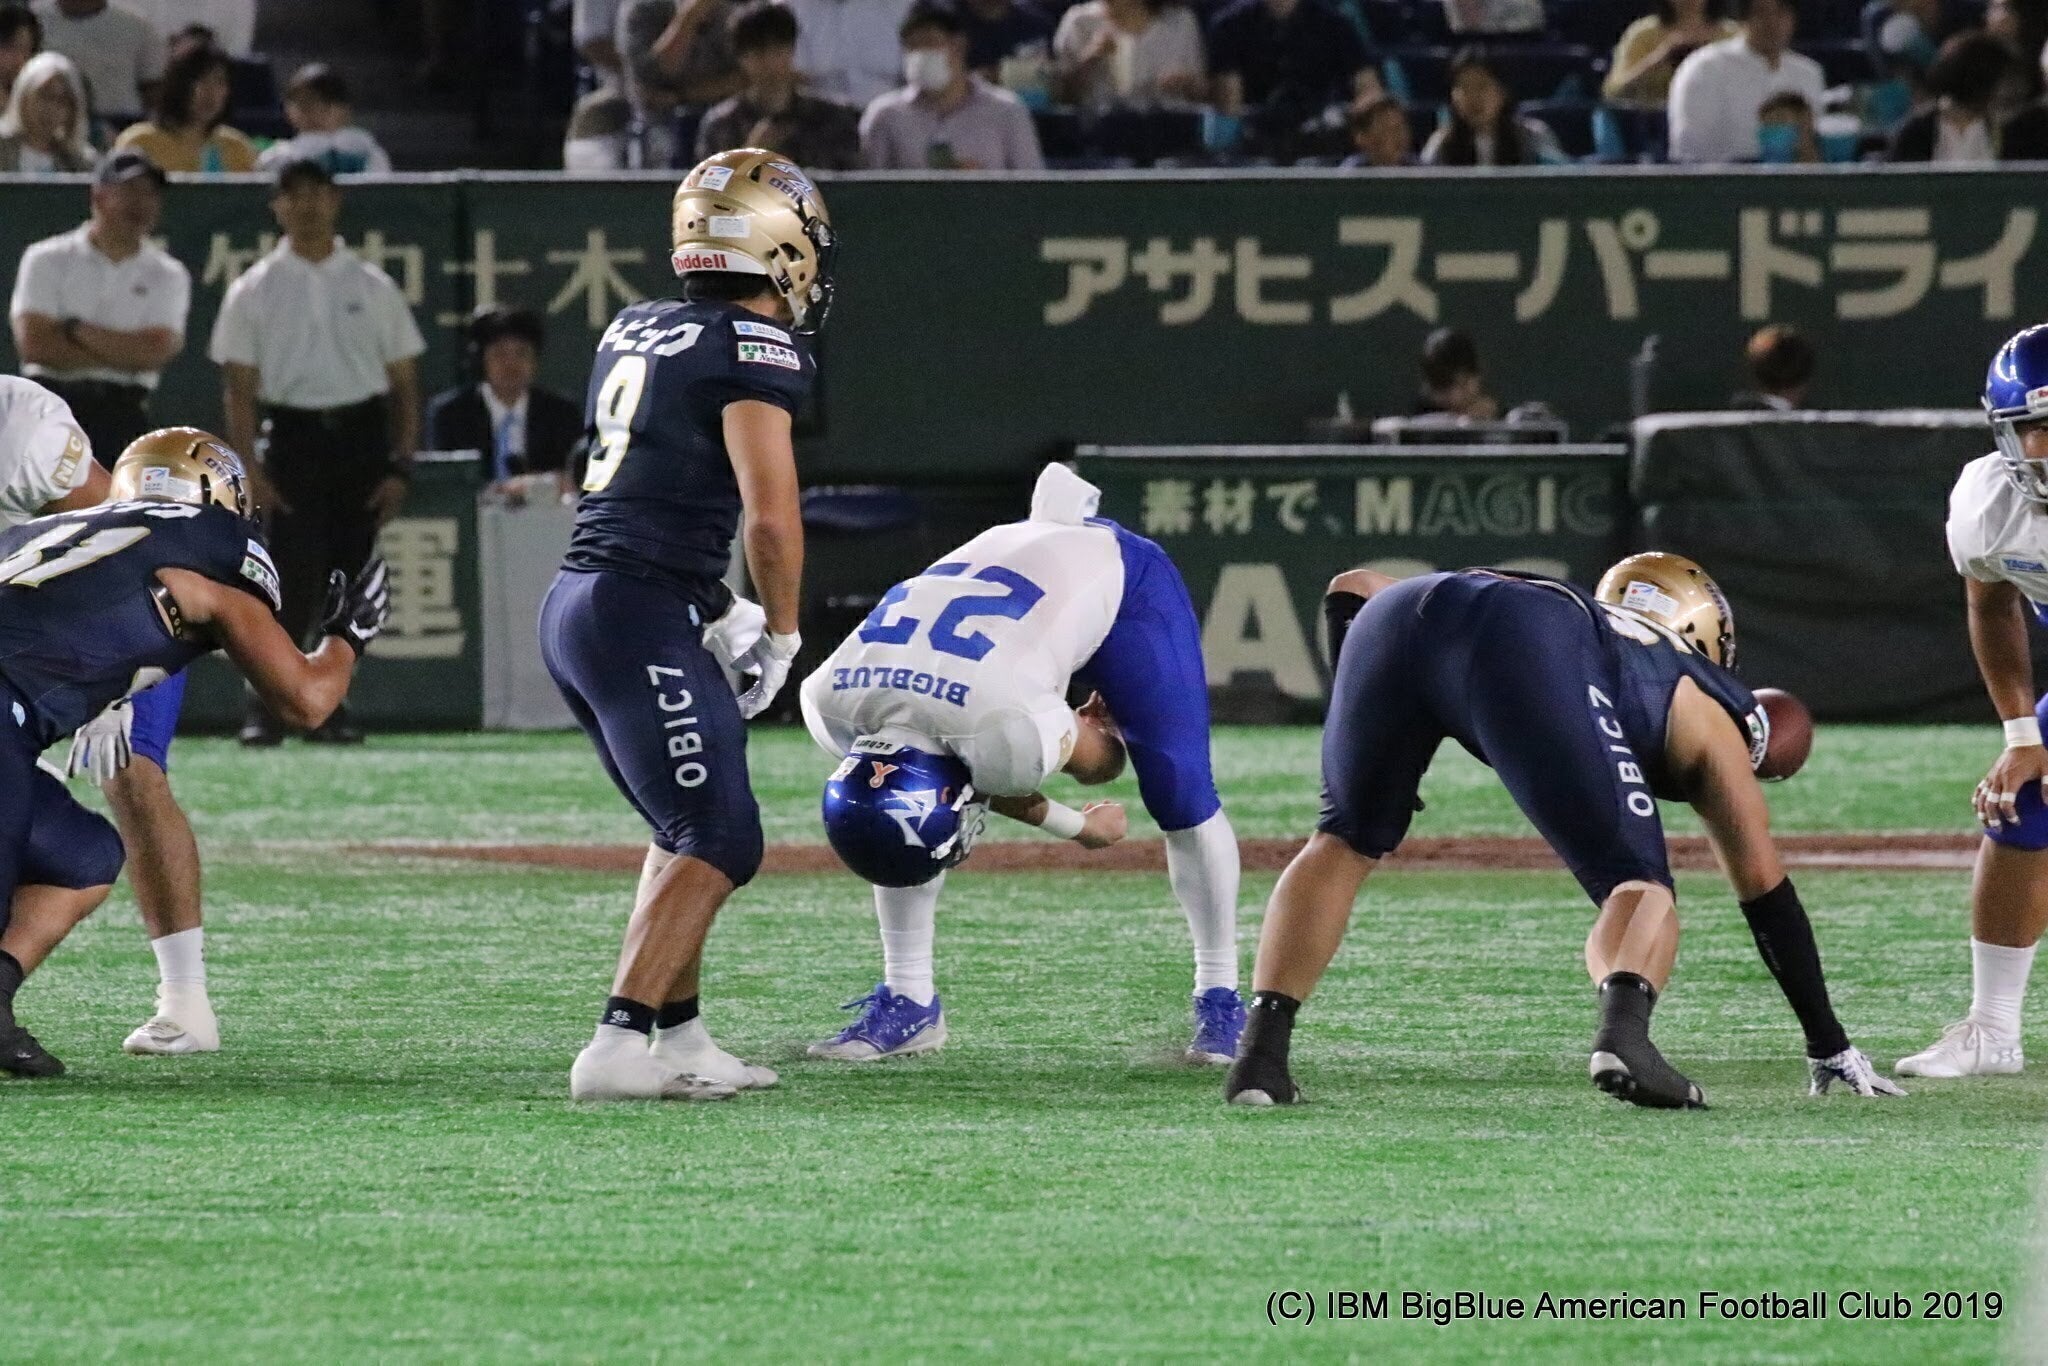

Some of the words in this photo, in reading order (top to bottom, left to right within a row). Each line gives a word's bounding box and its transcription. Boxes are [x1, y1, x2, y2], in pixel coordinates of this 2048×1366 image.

[674, 254, 727, 272] Riddell
[1041, 207, 2038, 326] アサヒスーパードライ
[583, 355, 646, 491] 9
[646, 664, 708, 788] OBIC7
[832, 667, 970, 707] BIGBLUE
[1588, 684, 1654, 817] OBIC7
